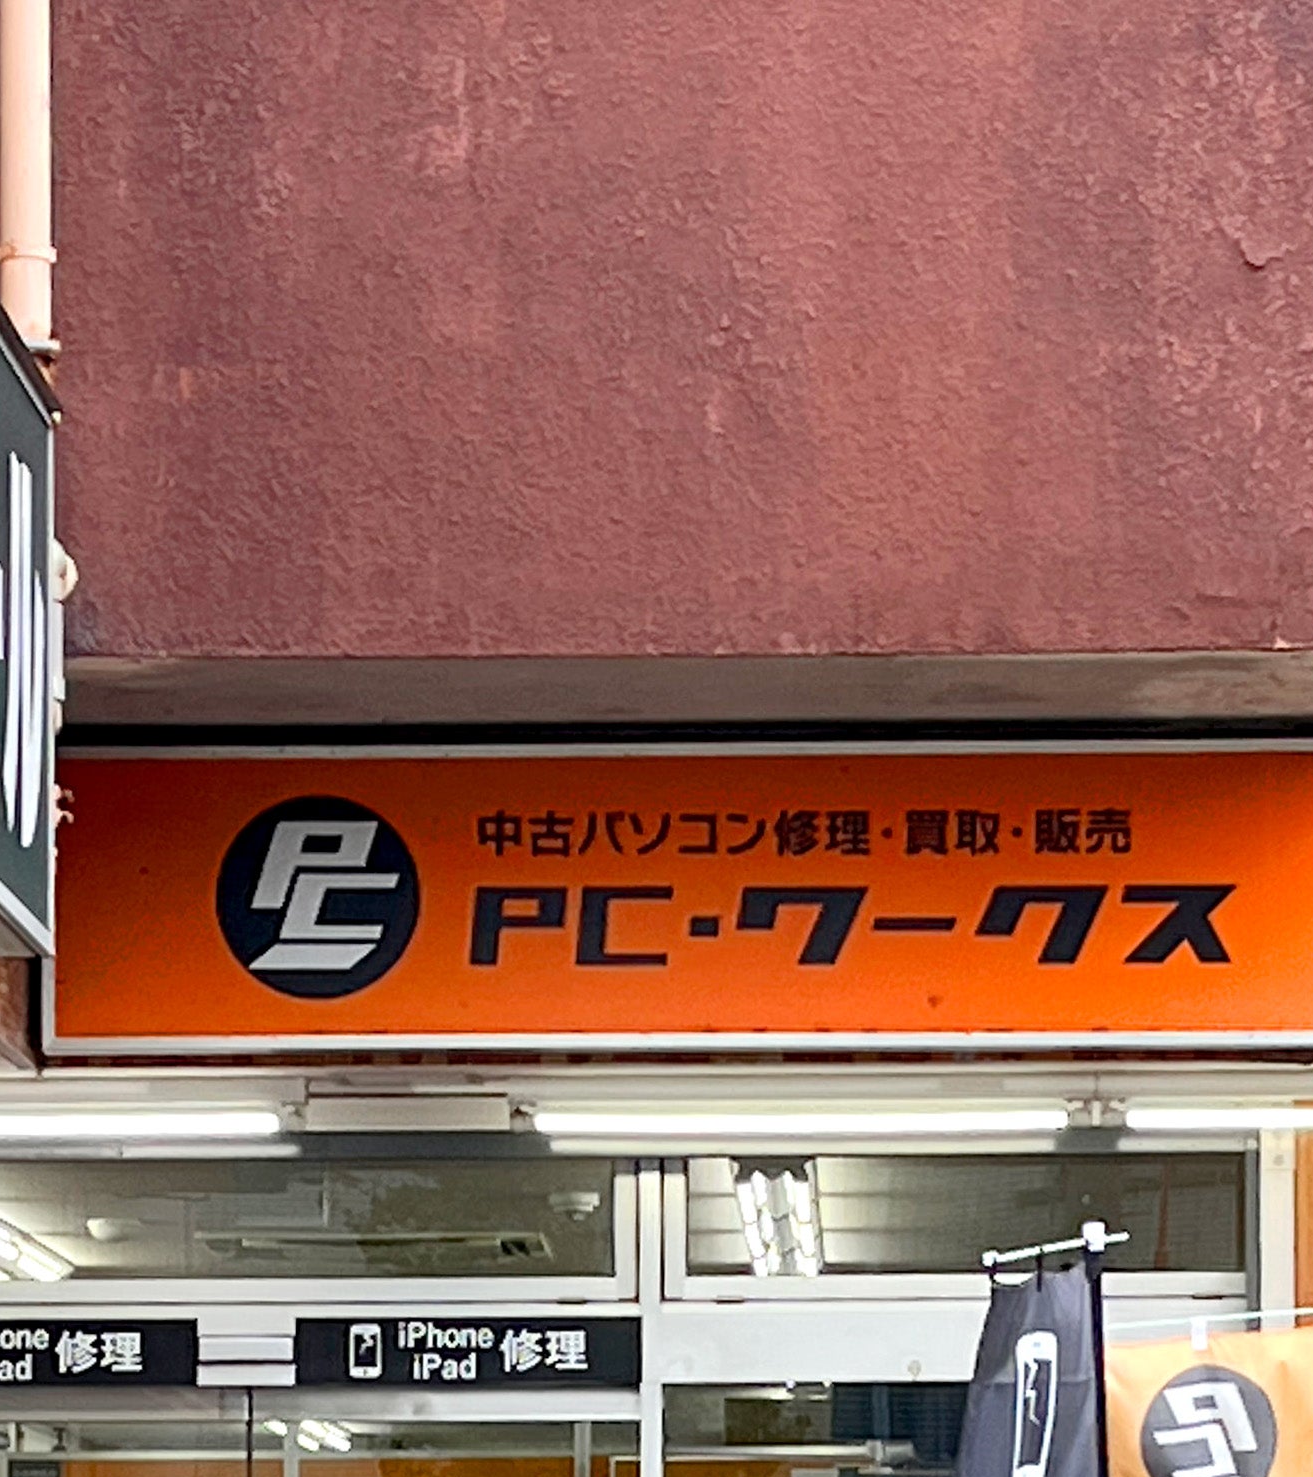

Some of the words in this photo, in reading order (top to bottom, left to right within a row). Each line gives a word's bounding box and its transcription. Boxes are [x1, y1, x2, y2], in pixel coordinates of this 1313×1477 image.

[476, 809, 1132, 858] 中古パソコン修理・買取・販売
[469, 885, 1238, 966] PC・ワークス
[54, 1329, 143, 1374] 修理
[397, 1321, 495, 1349] iPhone
[499, 1329, 589, 1373] 修理
[413, 1352, 477, 1381] iPad
